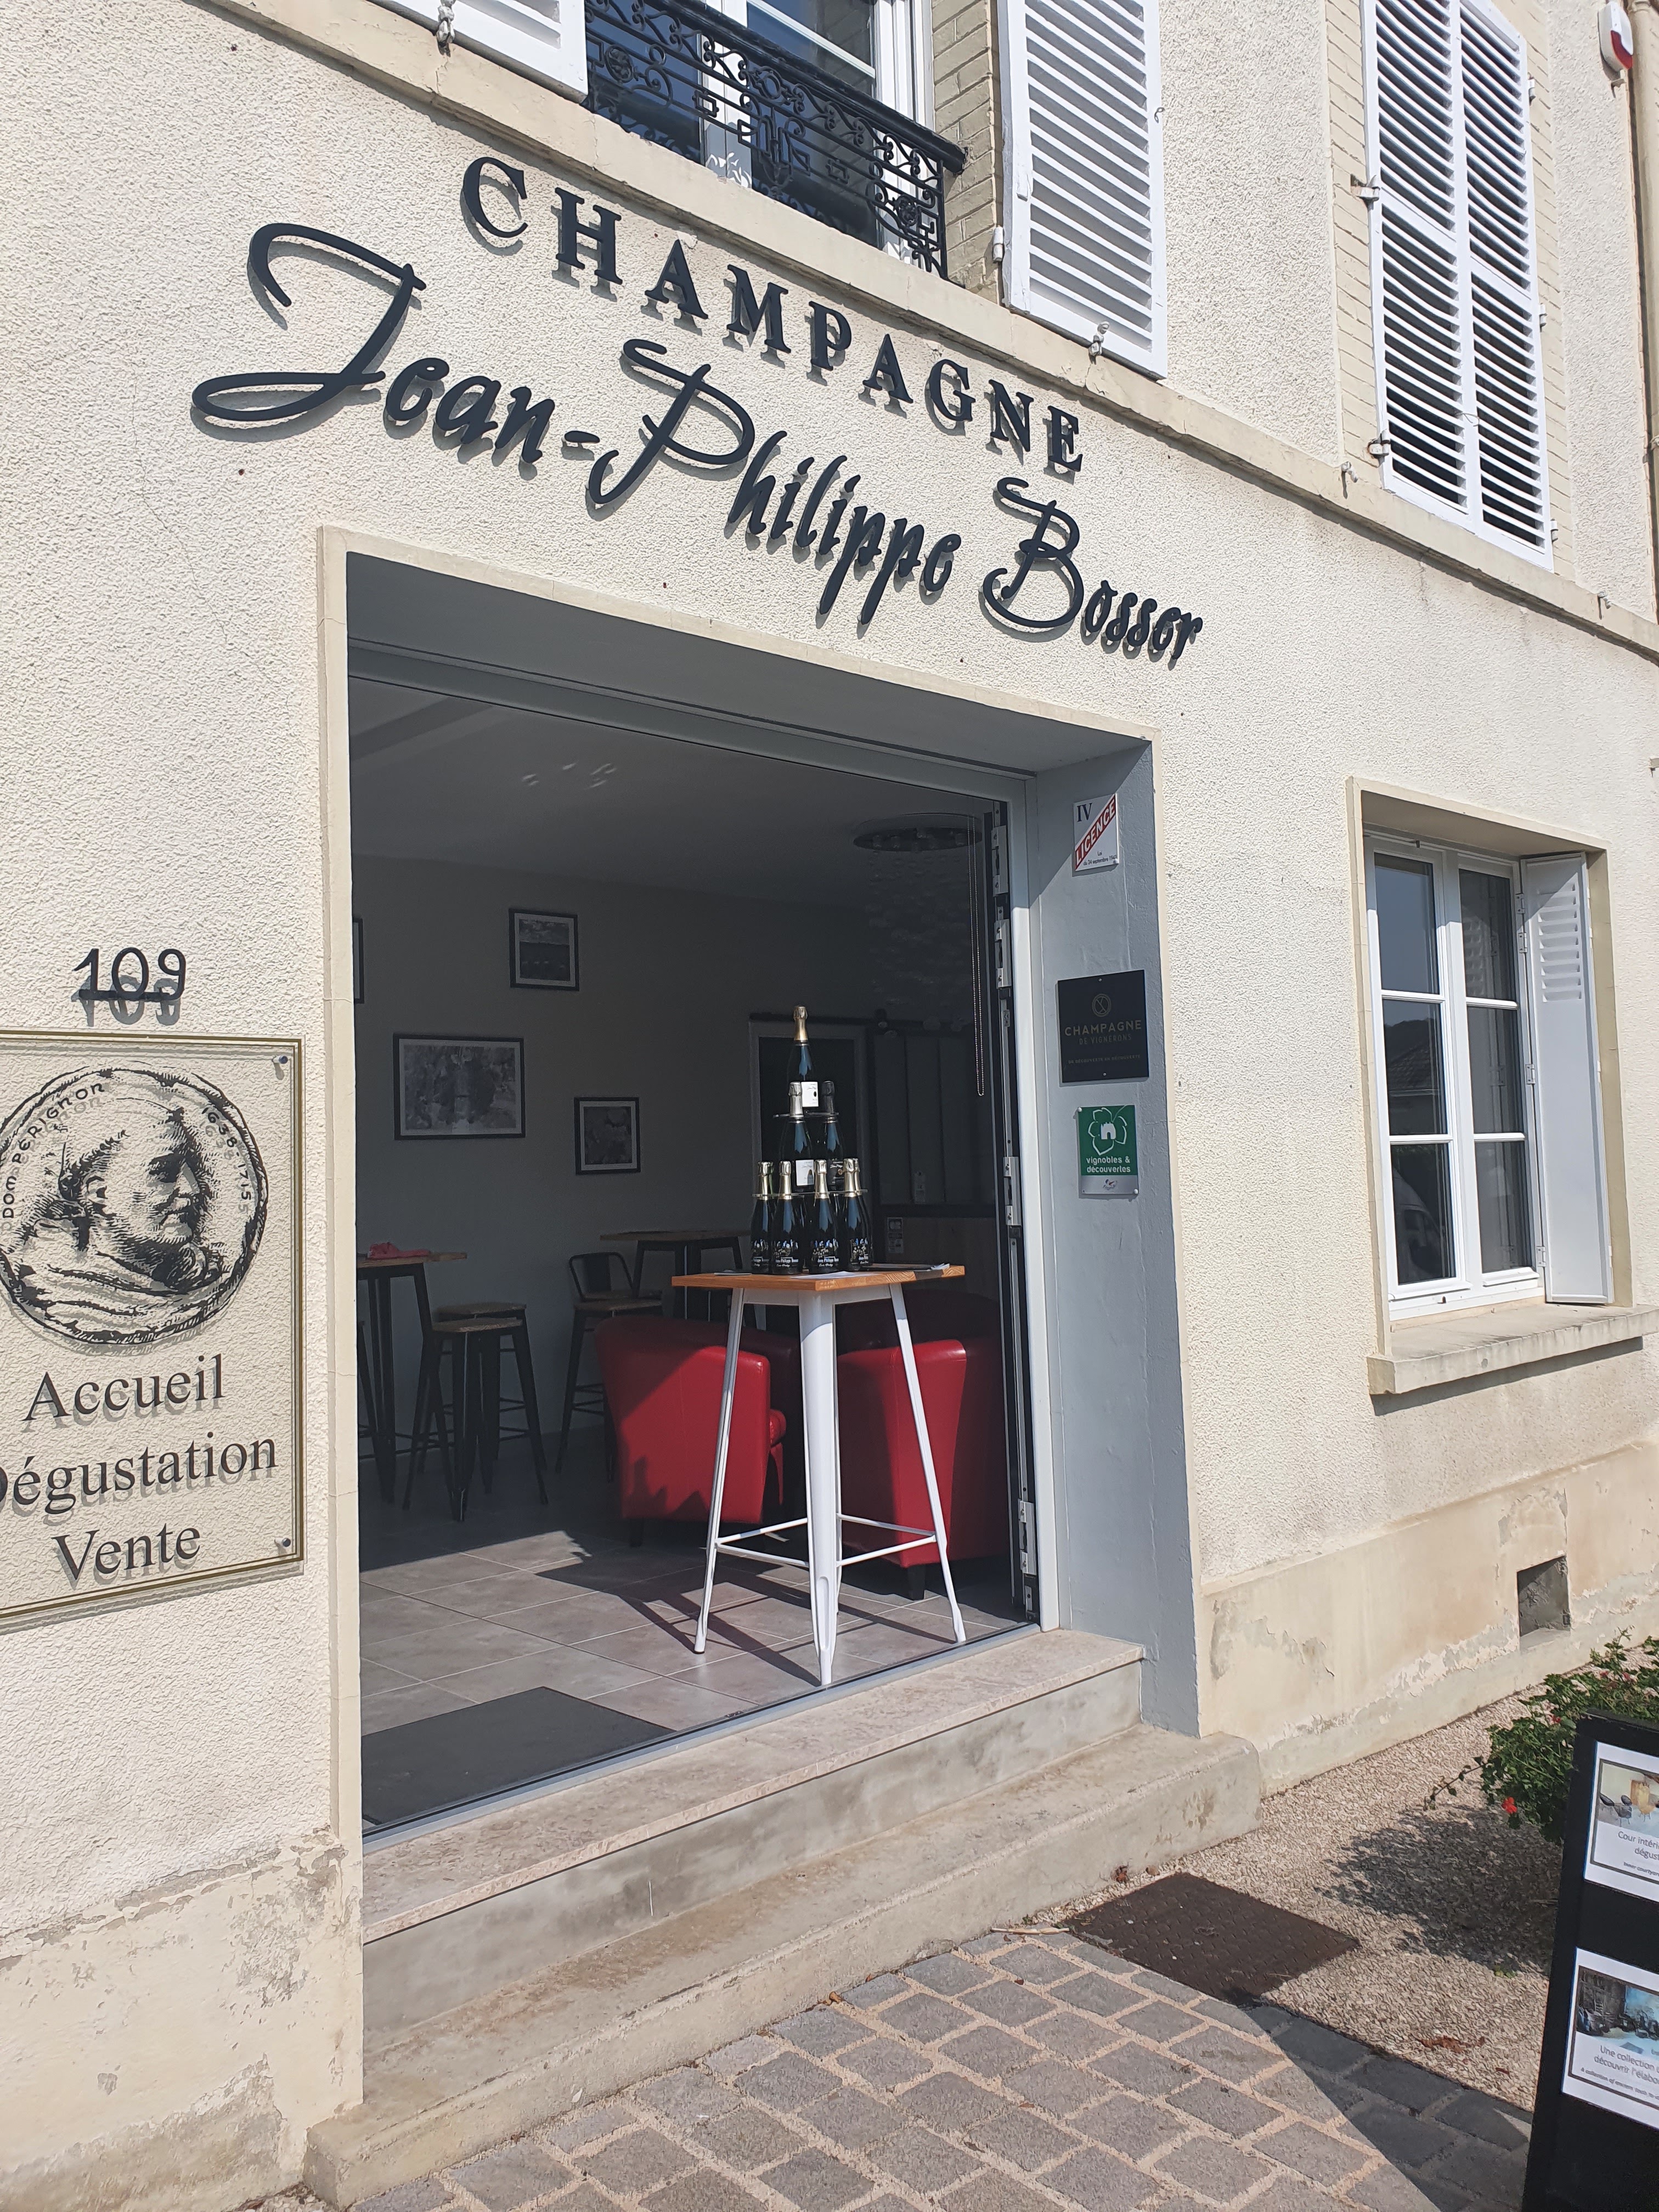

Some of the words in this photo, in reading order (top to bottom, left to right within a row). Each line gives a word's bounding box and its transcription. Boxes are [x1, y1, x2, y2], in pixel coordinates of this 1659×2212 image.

[462, 157, 1082, 472] CHAMPAGNE
[983, 477, 1203, 658] Bosser
[1076, 803, 1093, 822] IV
[1076, 799, 1116, 866] LICENCE
[74, 947, 187, 1001] 109
[1064, 1019, 1142, 1036] CHAMPAGNE
[1091, 1034, 1132, 1045] VIGNERONS
[201, 1107, 252, 1200] 1638-1715
[1086, 1156, 1122, 1165] vignobles
[2, 1175, 17, 1218] DOM
[22, 1353, 225, 1421] Accueil
[0, 1431, 279, 1514] égustation
[51, 1522, 201, 1581] Vente
[1618, 1831, 1636, 1842] Cour
[1638, 1836, 1659, 1850] intéri
[1594, 2055, 1629, 2073] découvrir
[1600, 2045, 1615, 2057] Une
[1617, 2053, 1655, 2071] collection
